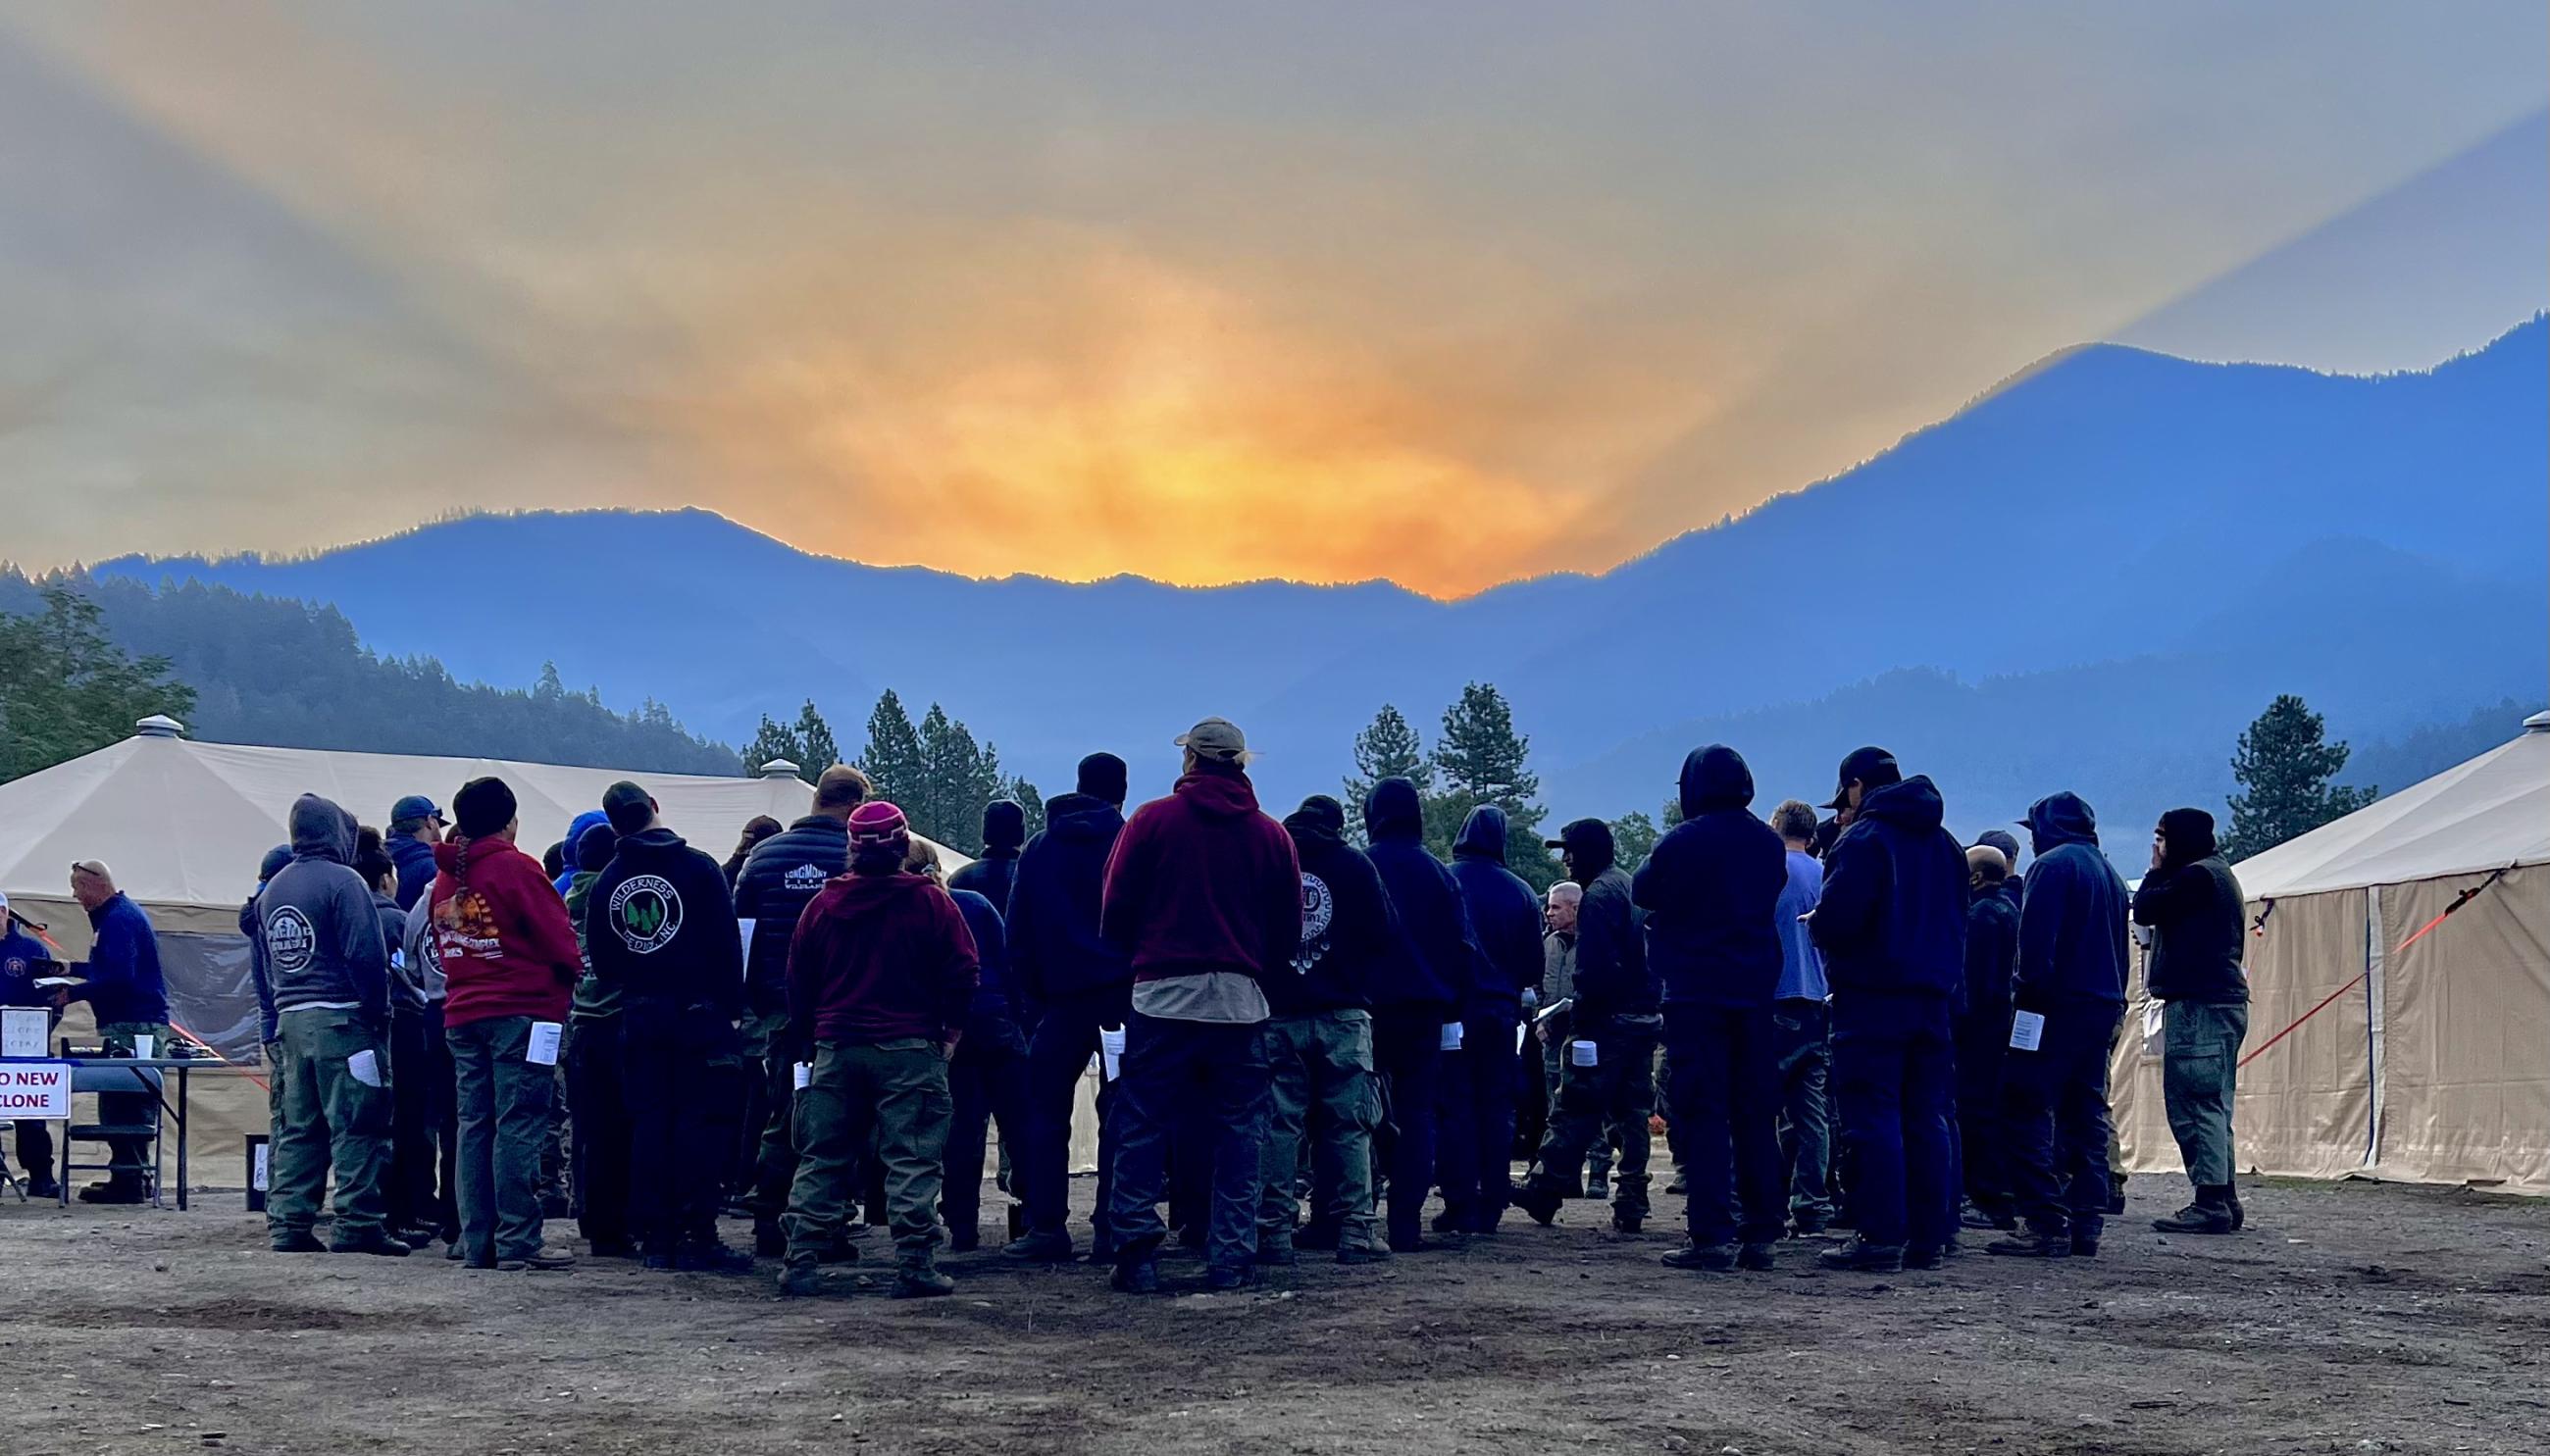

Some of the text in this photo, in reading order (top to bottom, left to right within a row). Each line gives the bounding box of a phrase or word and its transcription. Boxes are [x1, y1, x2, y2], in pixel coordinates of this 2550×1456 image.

[785, 863, 827, 879] LONGMONT
[611, 879, 674, 910] WILDERNESS
[0, 1073, 59, 1085] O NEW
[0, 1094, 49, 1108] LONE
